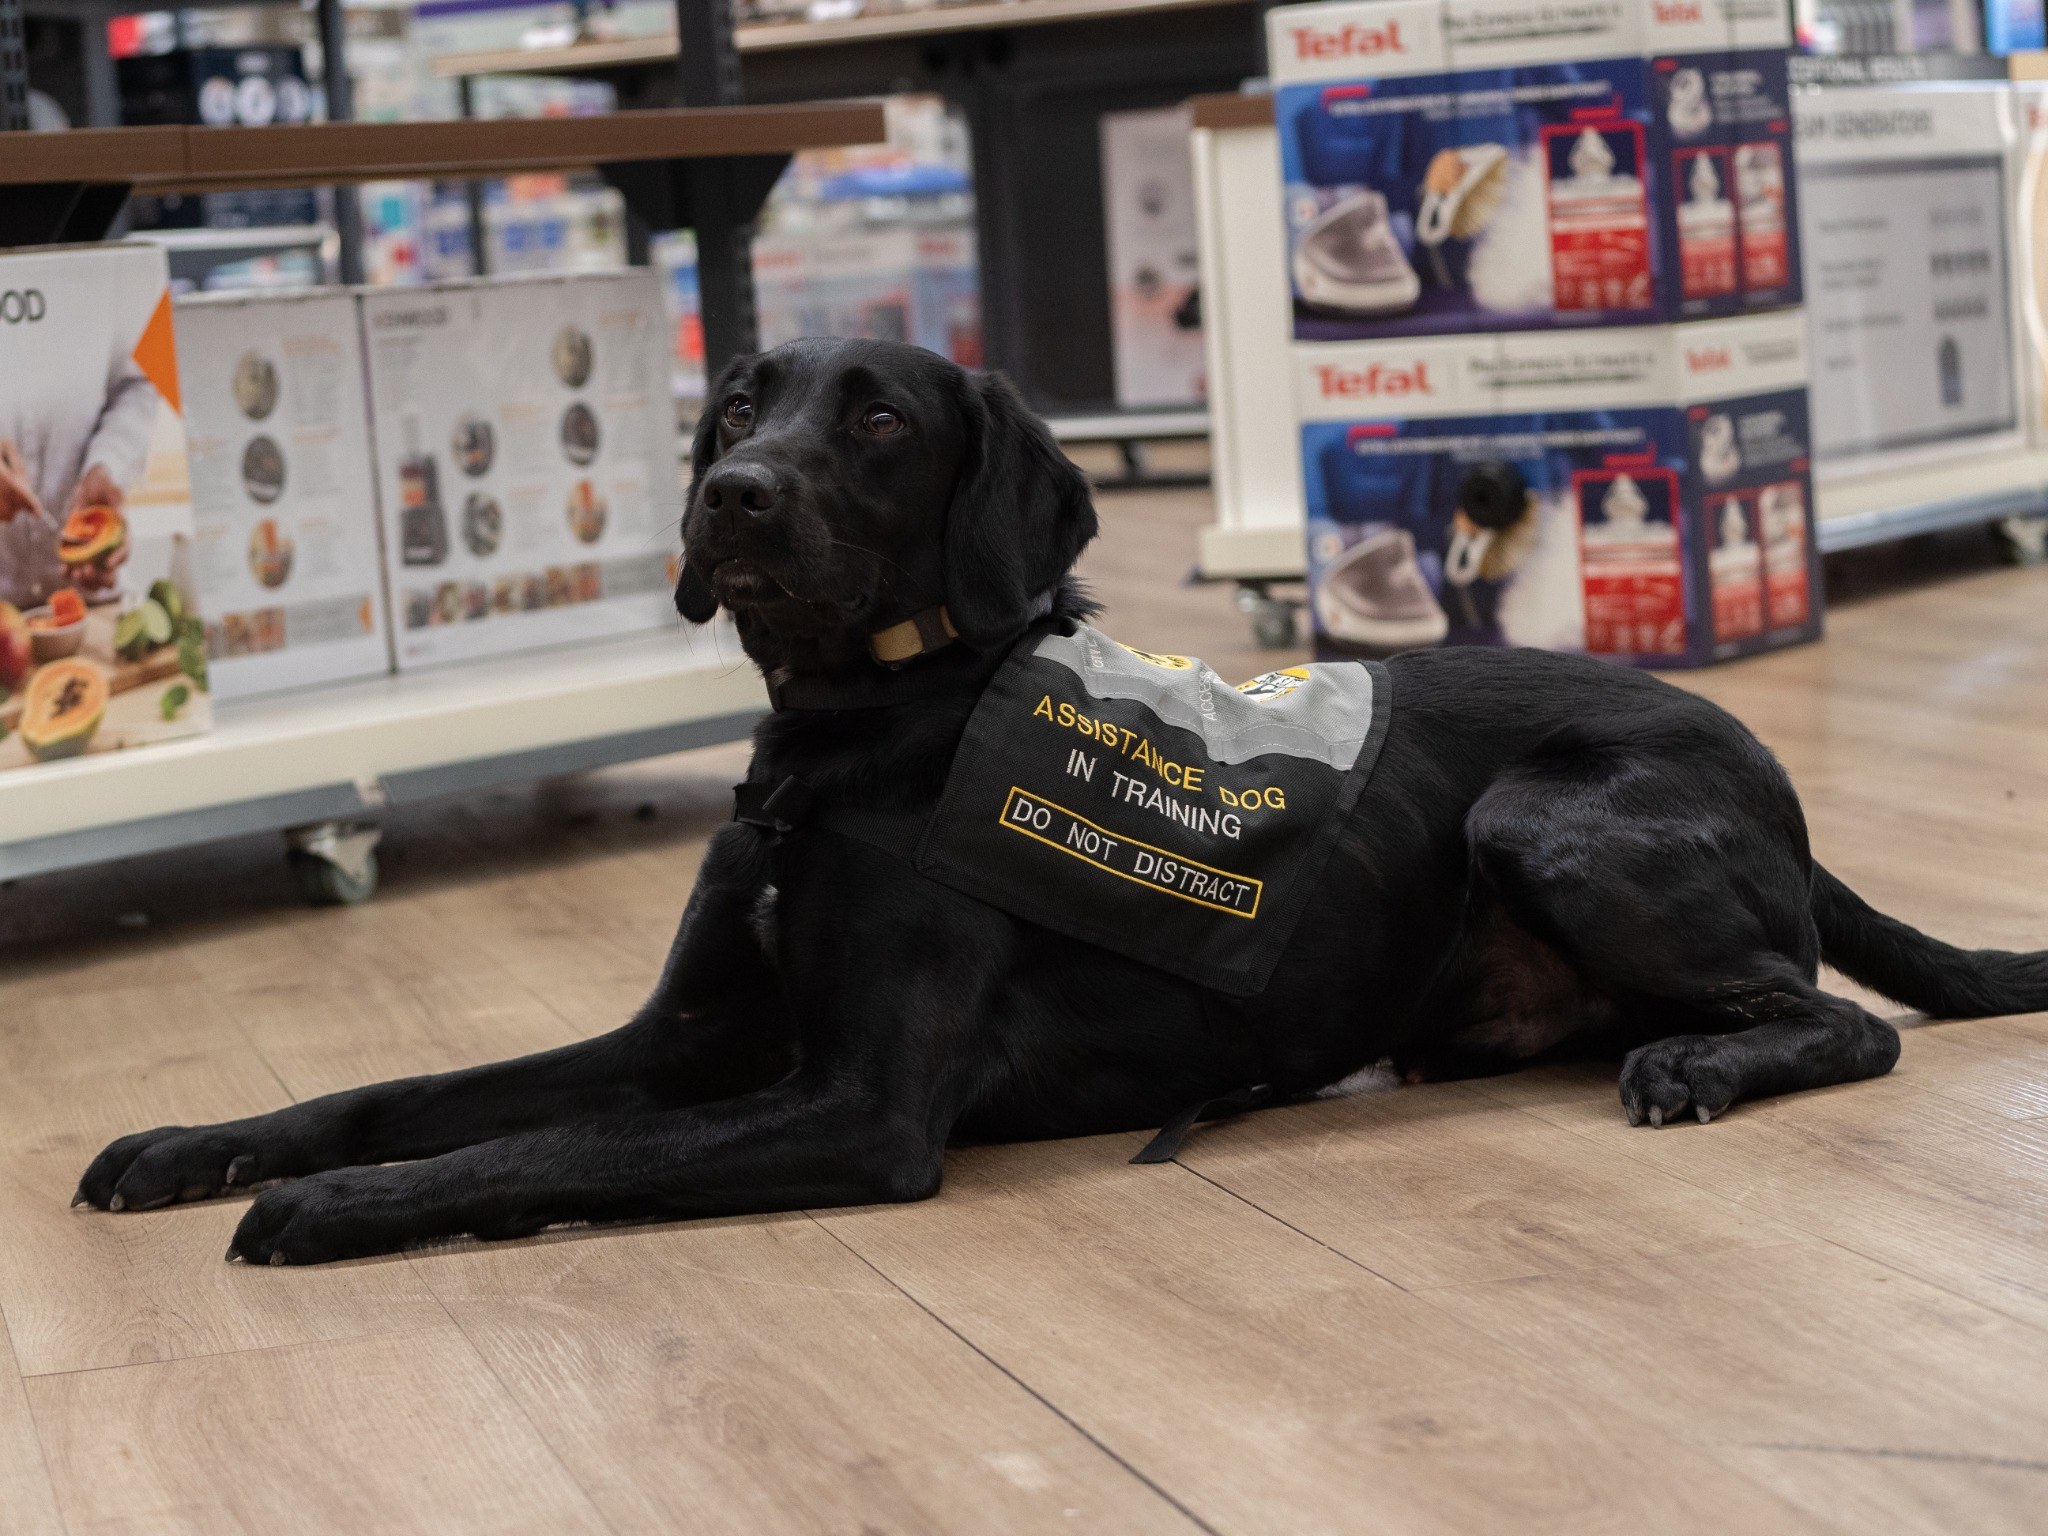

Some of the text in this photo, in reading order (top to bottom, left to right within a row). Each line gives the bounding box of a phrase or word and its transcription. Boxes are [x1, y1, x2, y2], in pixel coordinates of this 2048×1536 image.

[1290, 19, 1406, 58] Tefal
[0, 288, 46, 325] OD
[1315, 360, 1433, 398] Tefal
[1033, 694, 1286, 810] ASSISTANCE DOG
[1066, 748, 1242, 840] IN TRAINING
[1011, 797, 1251, 907] DO NOT DISTRACT
